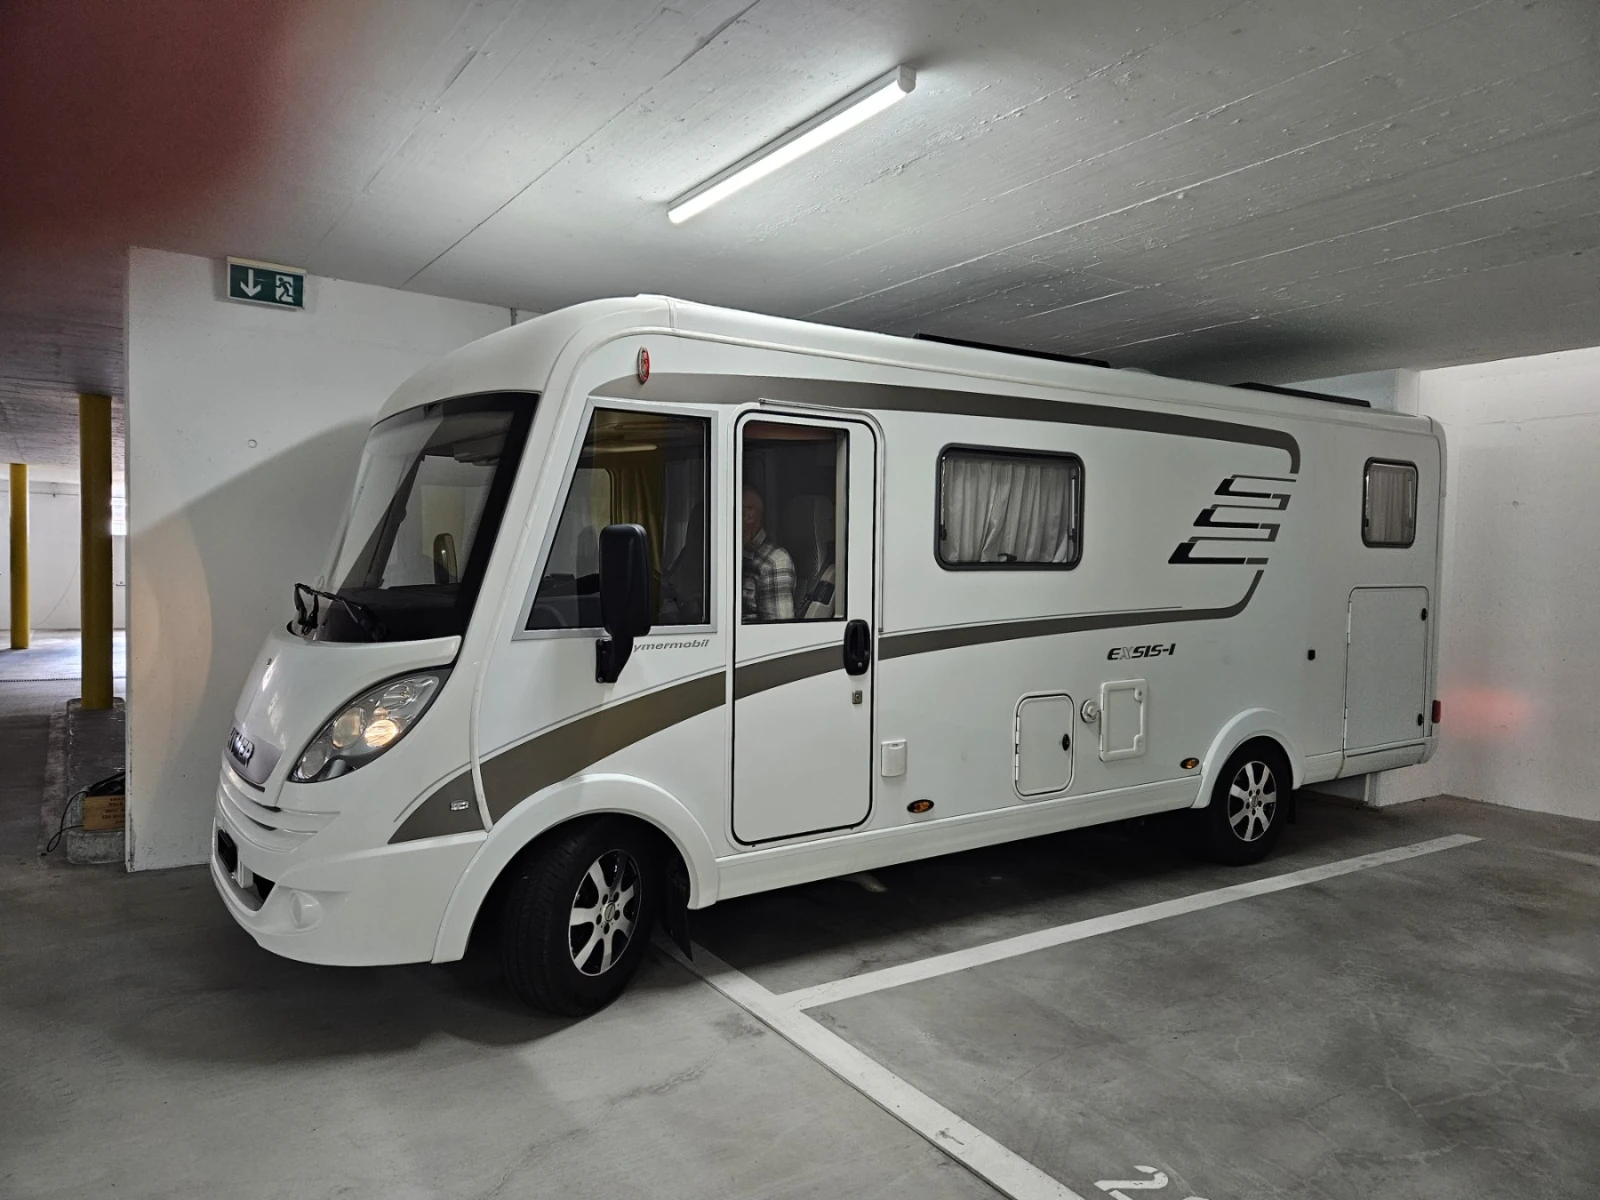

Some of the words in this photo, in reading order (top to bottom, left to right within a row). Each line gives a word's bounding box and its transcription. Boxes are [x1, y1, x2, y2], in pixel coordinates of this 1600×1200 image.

[633, 638, 710, 653] ymermobil
[1106, 643, 1177, 661] EXSIS-I
[1093, 1164, 1210, 1200] 2
